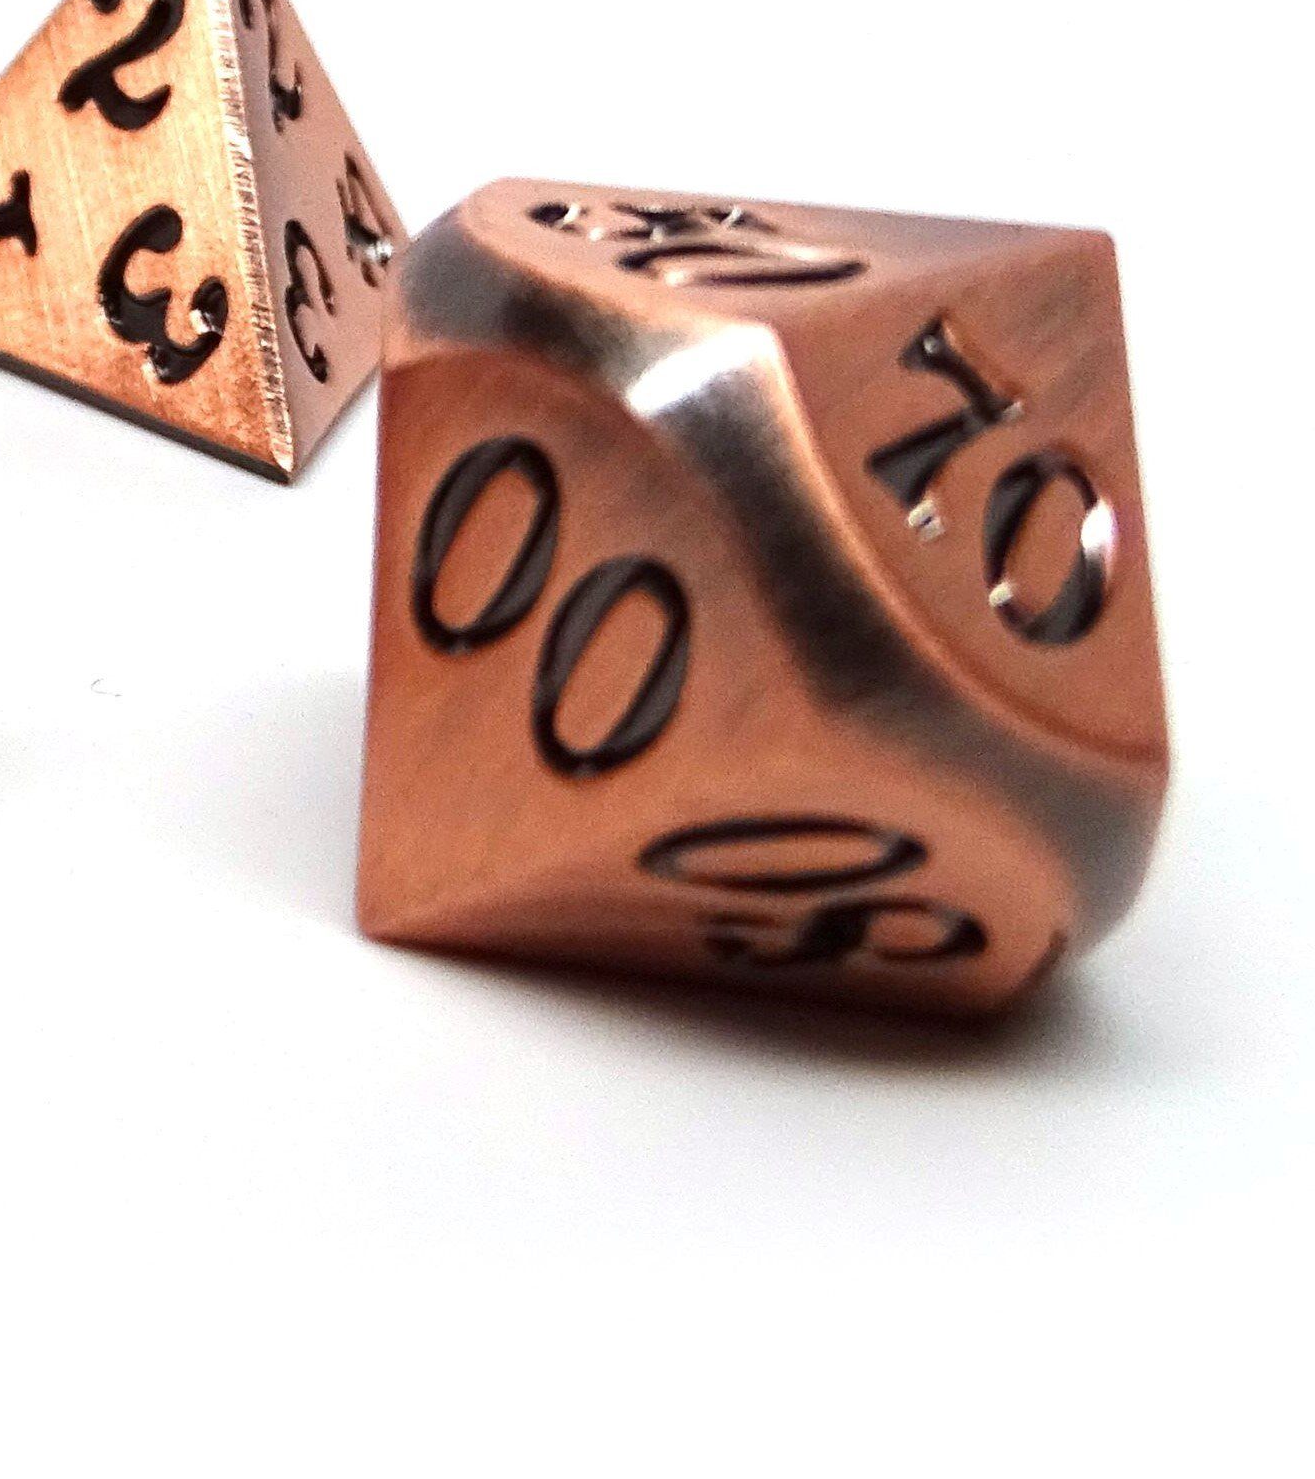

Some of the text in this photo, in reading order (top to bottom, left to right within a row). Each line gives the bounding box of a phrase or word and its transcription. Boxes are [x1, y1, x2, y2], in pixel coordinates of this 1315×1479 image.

[97, 203, 229, 387] 3
[283, 218, 336, 384] 3
[413, 435, 691, 780] 00
[868, 316, 1119, 647] 70
